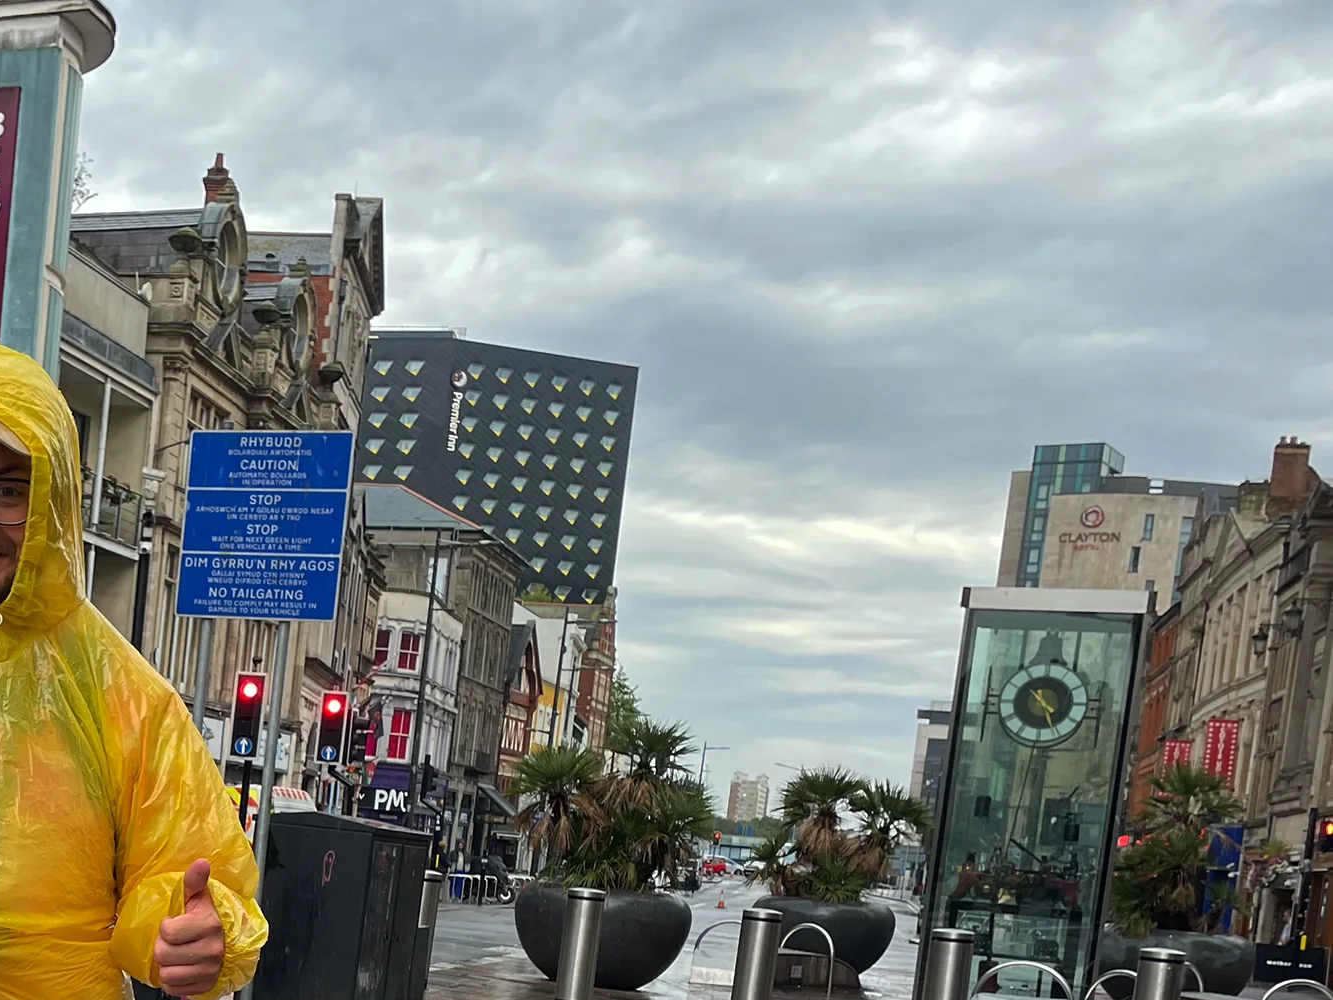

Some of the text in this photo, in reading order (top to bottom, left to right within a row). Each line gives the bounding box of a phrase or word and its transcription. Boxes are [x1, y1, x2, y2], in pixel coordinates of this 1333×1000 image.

[447, 391, 464, 452] Premier Inn
[240, 437, 303, 448] RHYBUDD
[240, 459, 297, 471] CAUTION
[249, 494, 282, 506] STOP
[246, 524, 279, 535] STOP
[1059, 532, 1121, 543] CLAYTON
[185, 557, 335, 572] DIM GYRRU'N RHY AGOS
[208, 588, 304, 600] NO TAILGATING
[270, 608, 300, 616] VEHICLE
